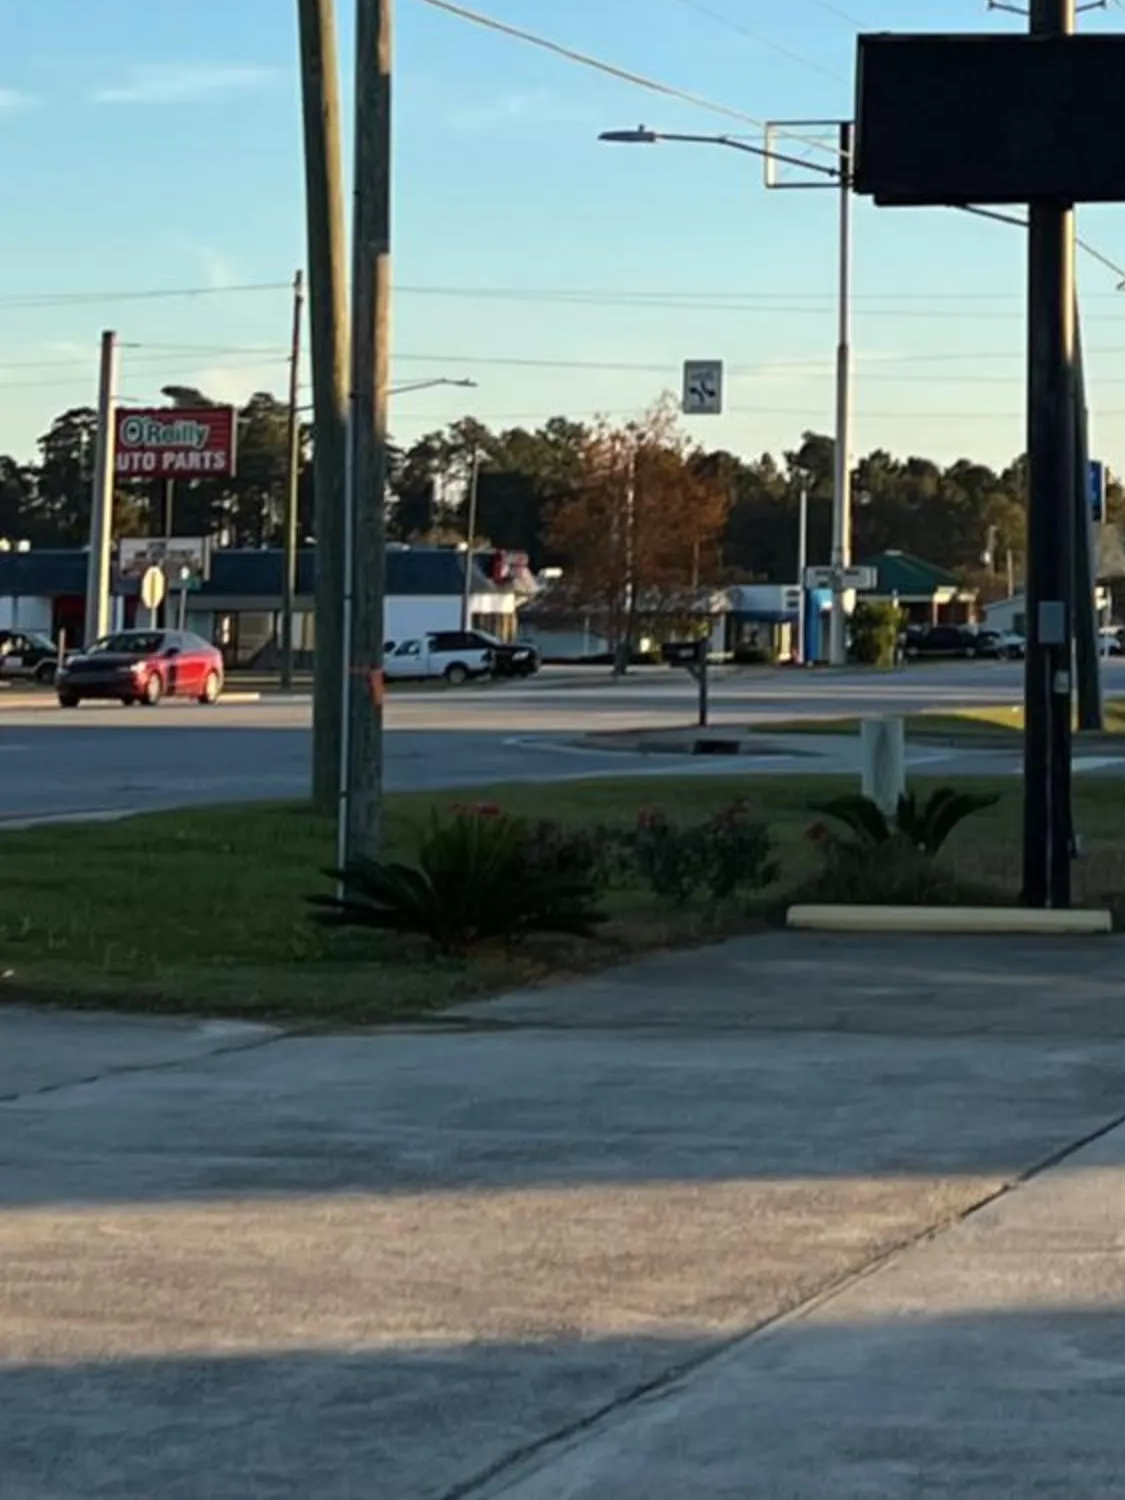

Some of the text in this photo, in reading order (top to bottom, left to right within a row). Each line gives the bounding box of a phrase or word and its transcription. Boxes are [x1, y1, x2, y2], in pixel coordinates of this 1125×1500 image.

[121, 416, 211, 450] O'Reilly
[117, 451, 227, 472] UTO PARTS
